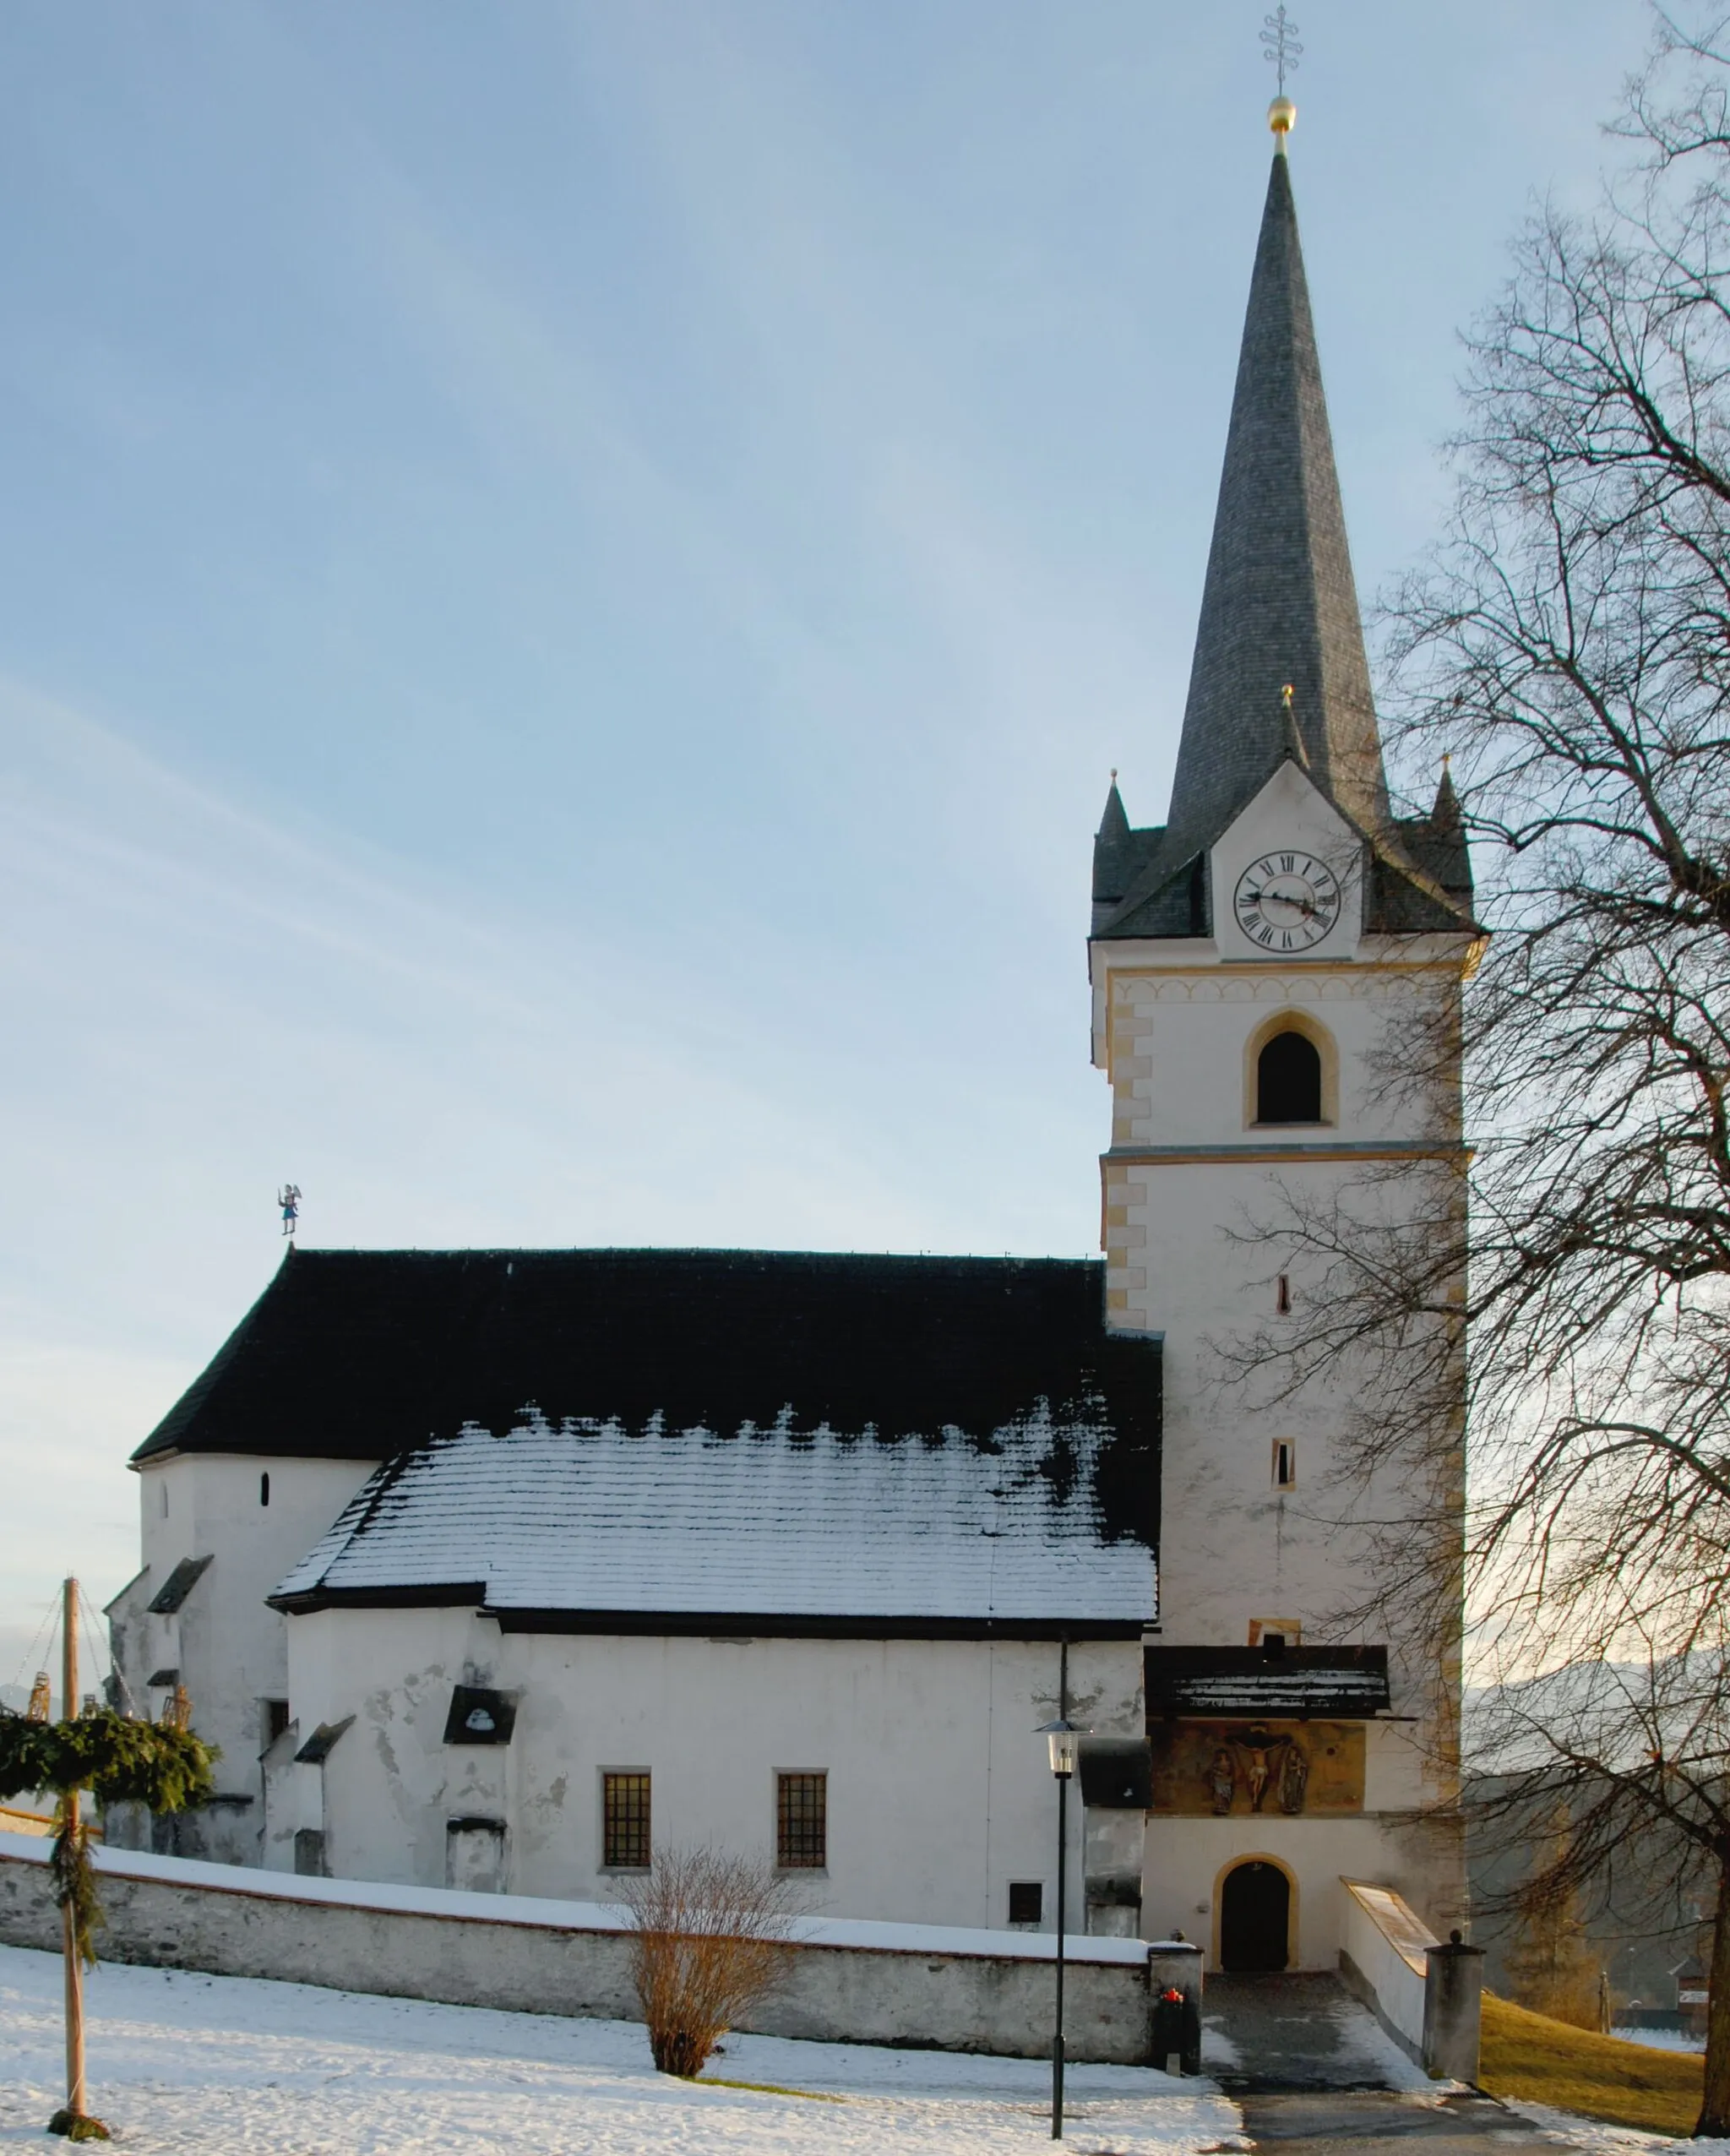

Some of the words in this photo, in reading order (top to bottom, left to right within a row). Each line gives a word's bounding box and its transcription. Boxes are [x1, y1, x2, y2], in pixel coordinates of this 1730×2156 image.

[1280, 855, 1294, 872] XII
[1302, 860, 1313, 876] I
[1313, 875, 1330, 890] II
